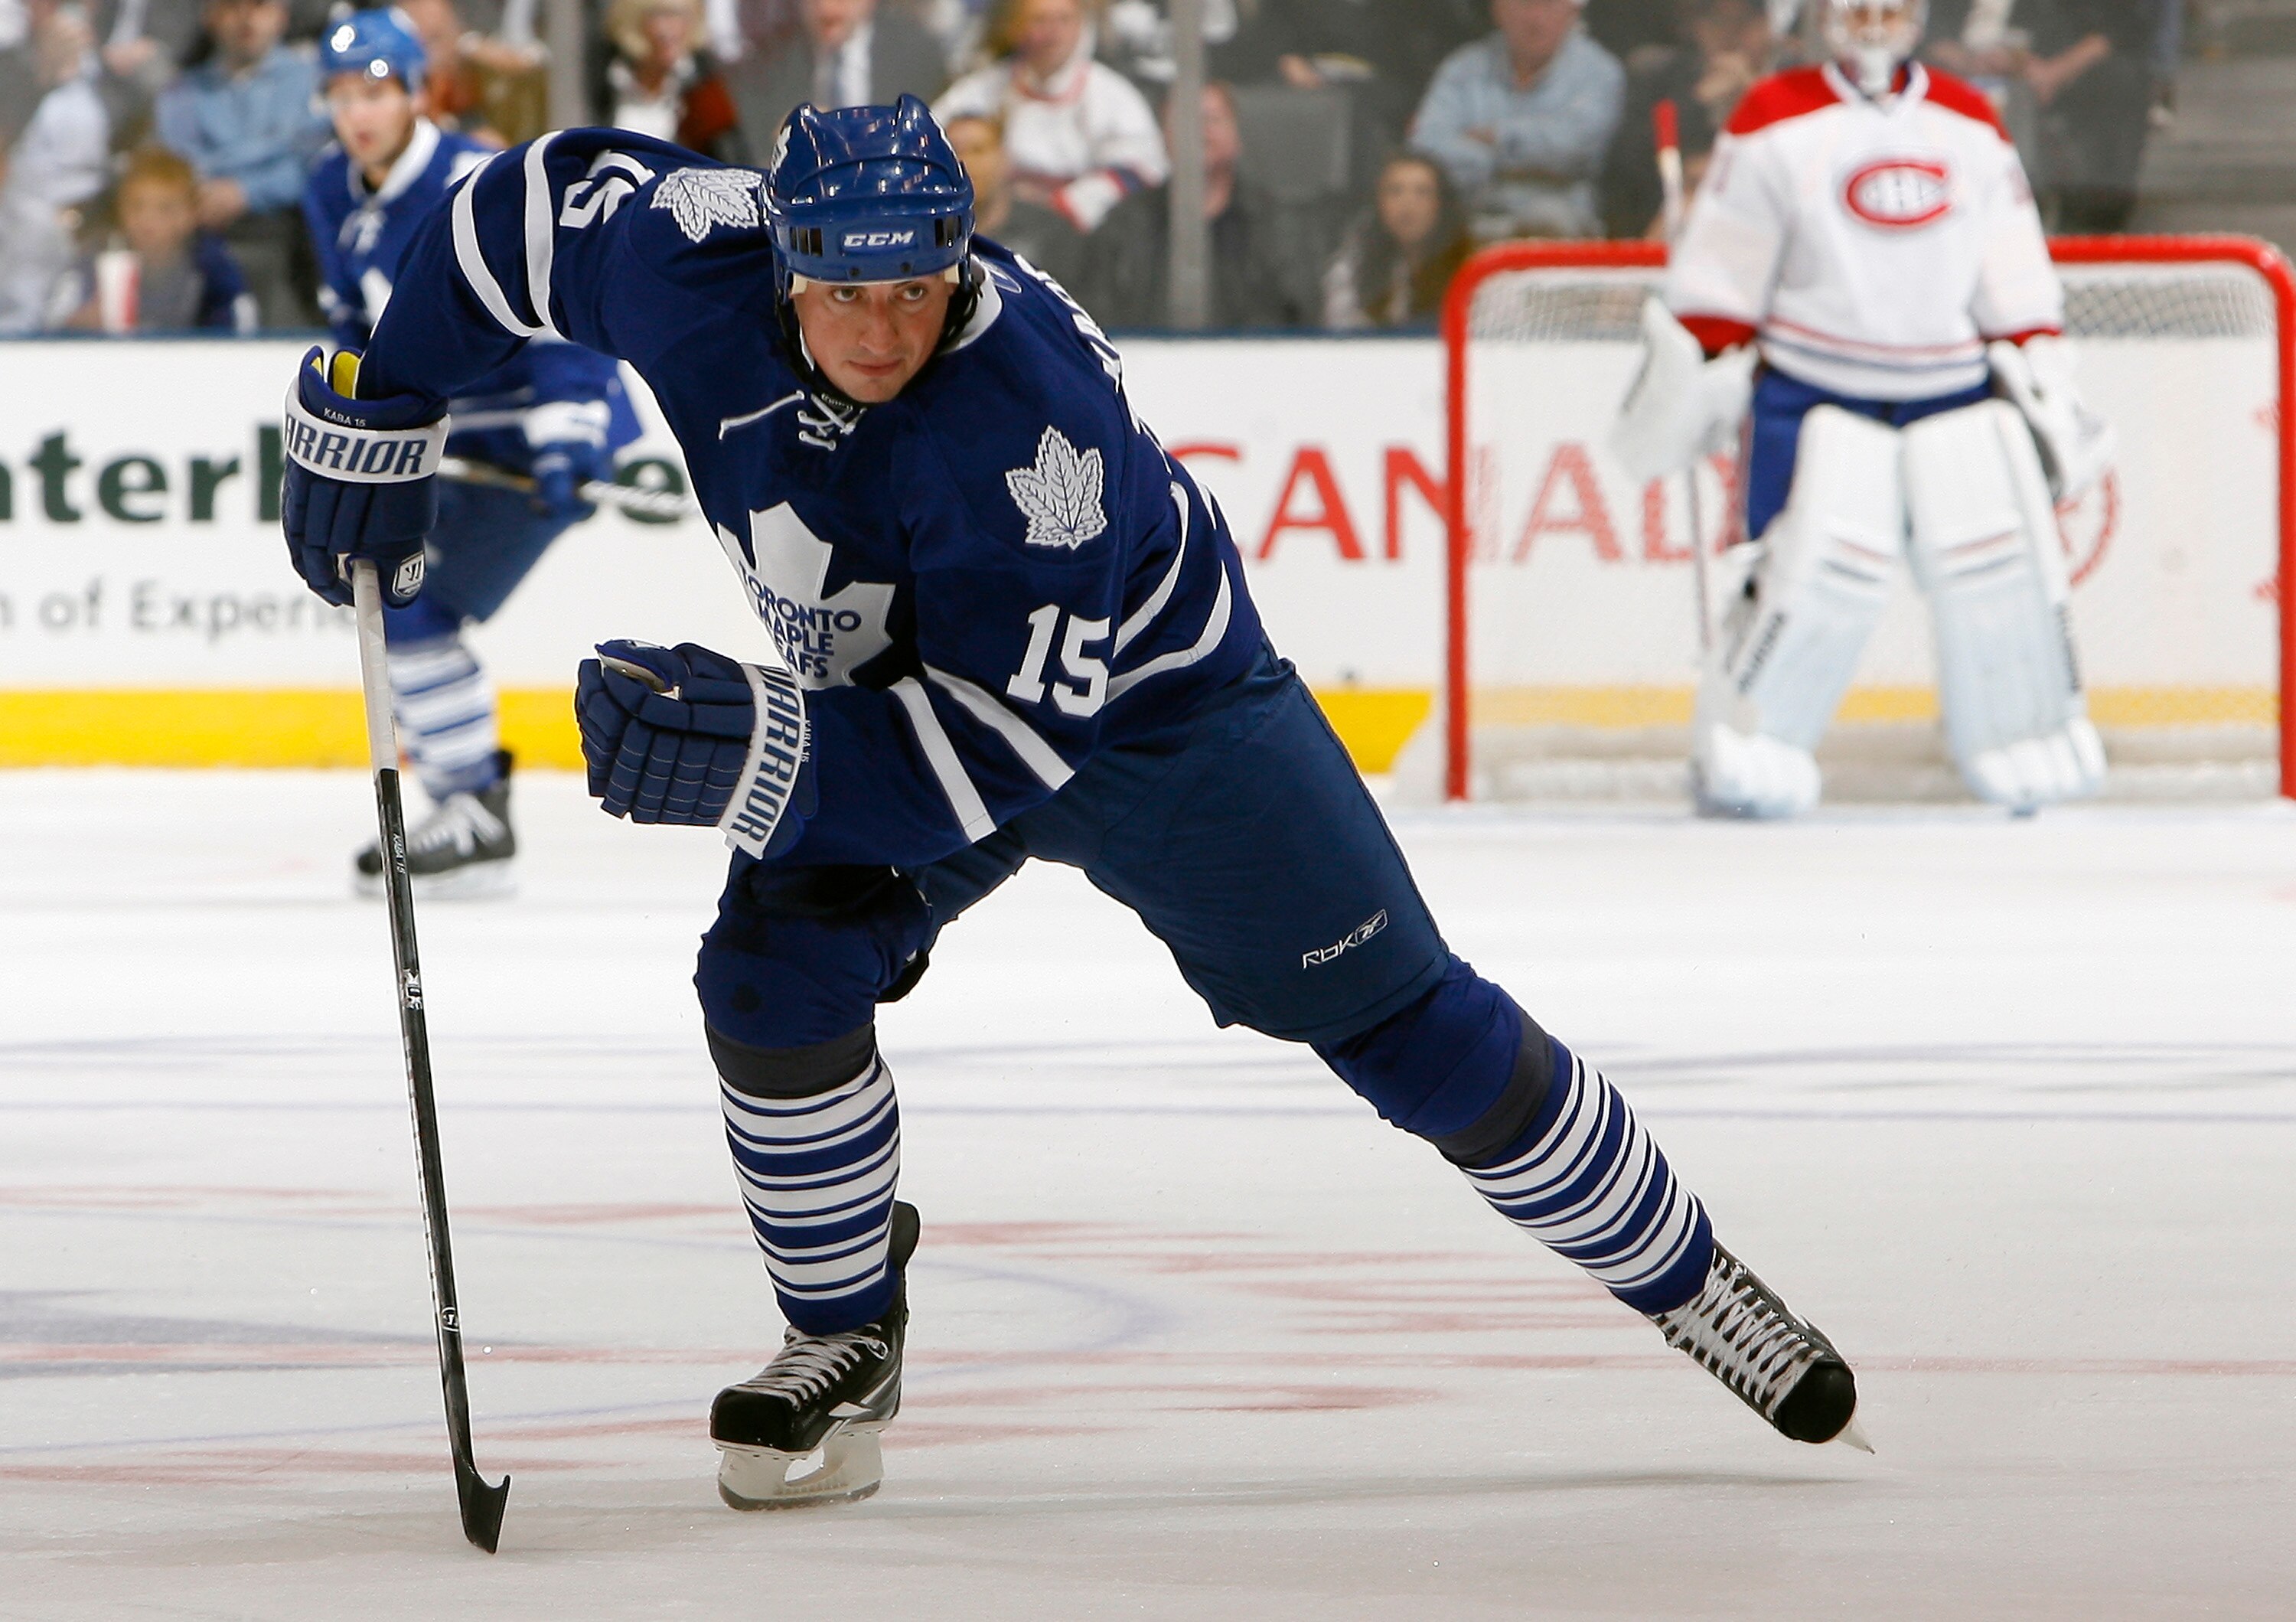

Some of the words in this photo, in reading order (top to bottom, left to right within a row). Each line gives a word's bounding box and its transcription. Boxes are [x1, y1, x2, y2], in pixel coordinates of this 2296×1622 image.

[843, 230, 915, 248] CCM
[285, 413, 428, 475] ARRIOR
[354, 418, 367, 427] 15
[40, 576, 105, 630] of
[738, 560, 862, 632] TORONTO
[757, 598, 835, 656] MAPLE
[1006, 603, 1111, 718] 15
